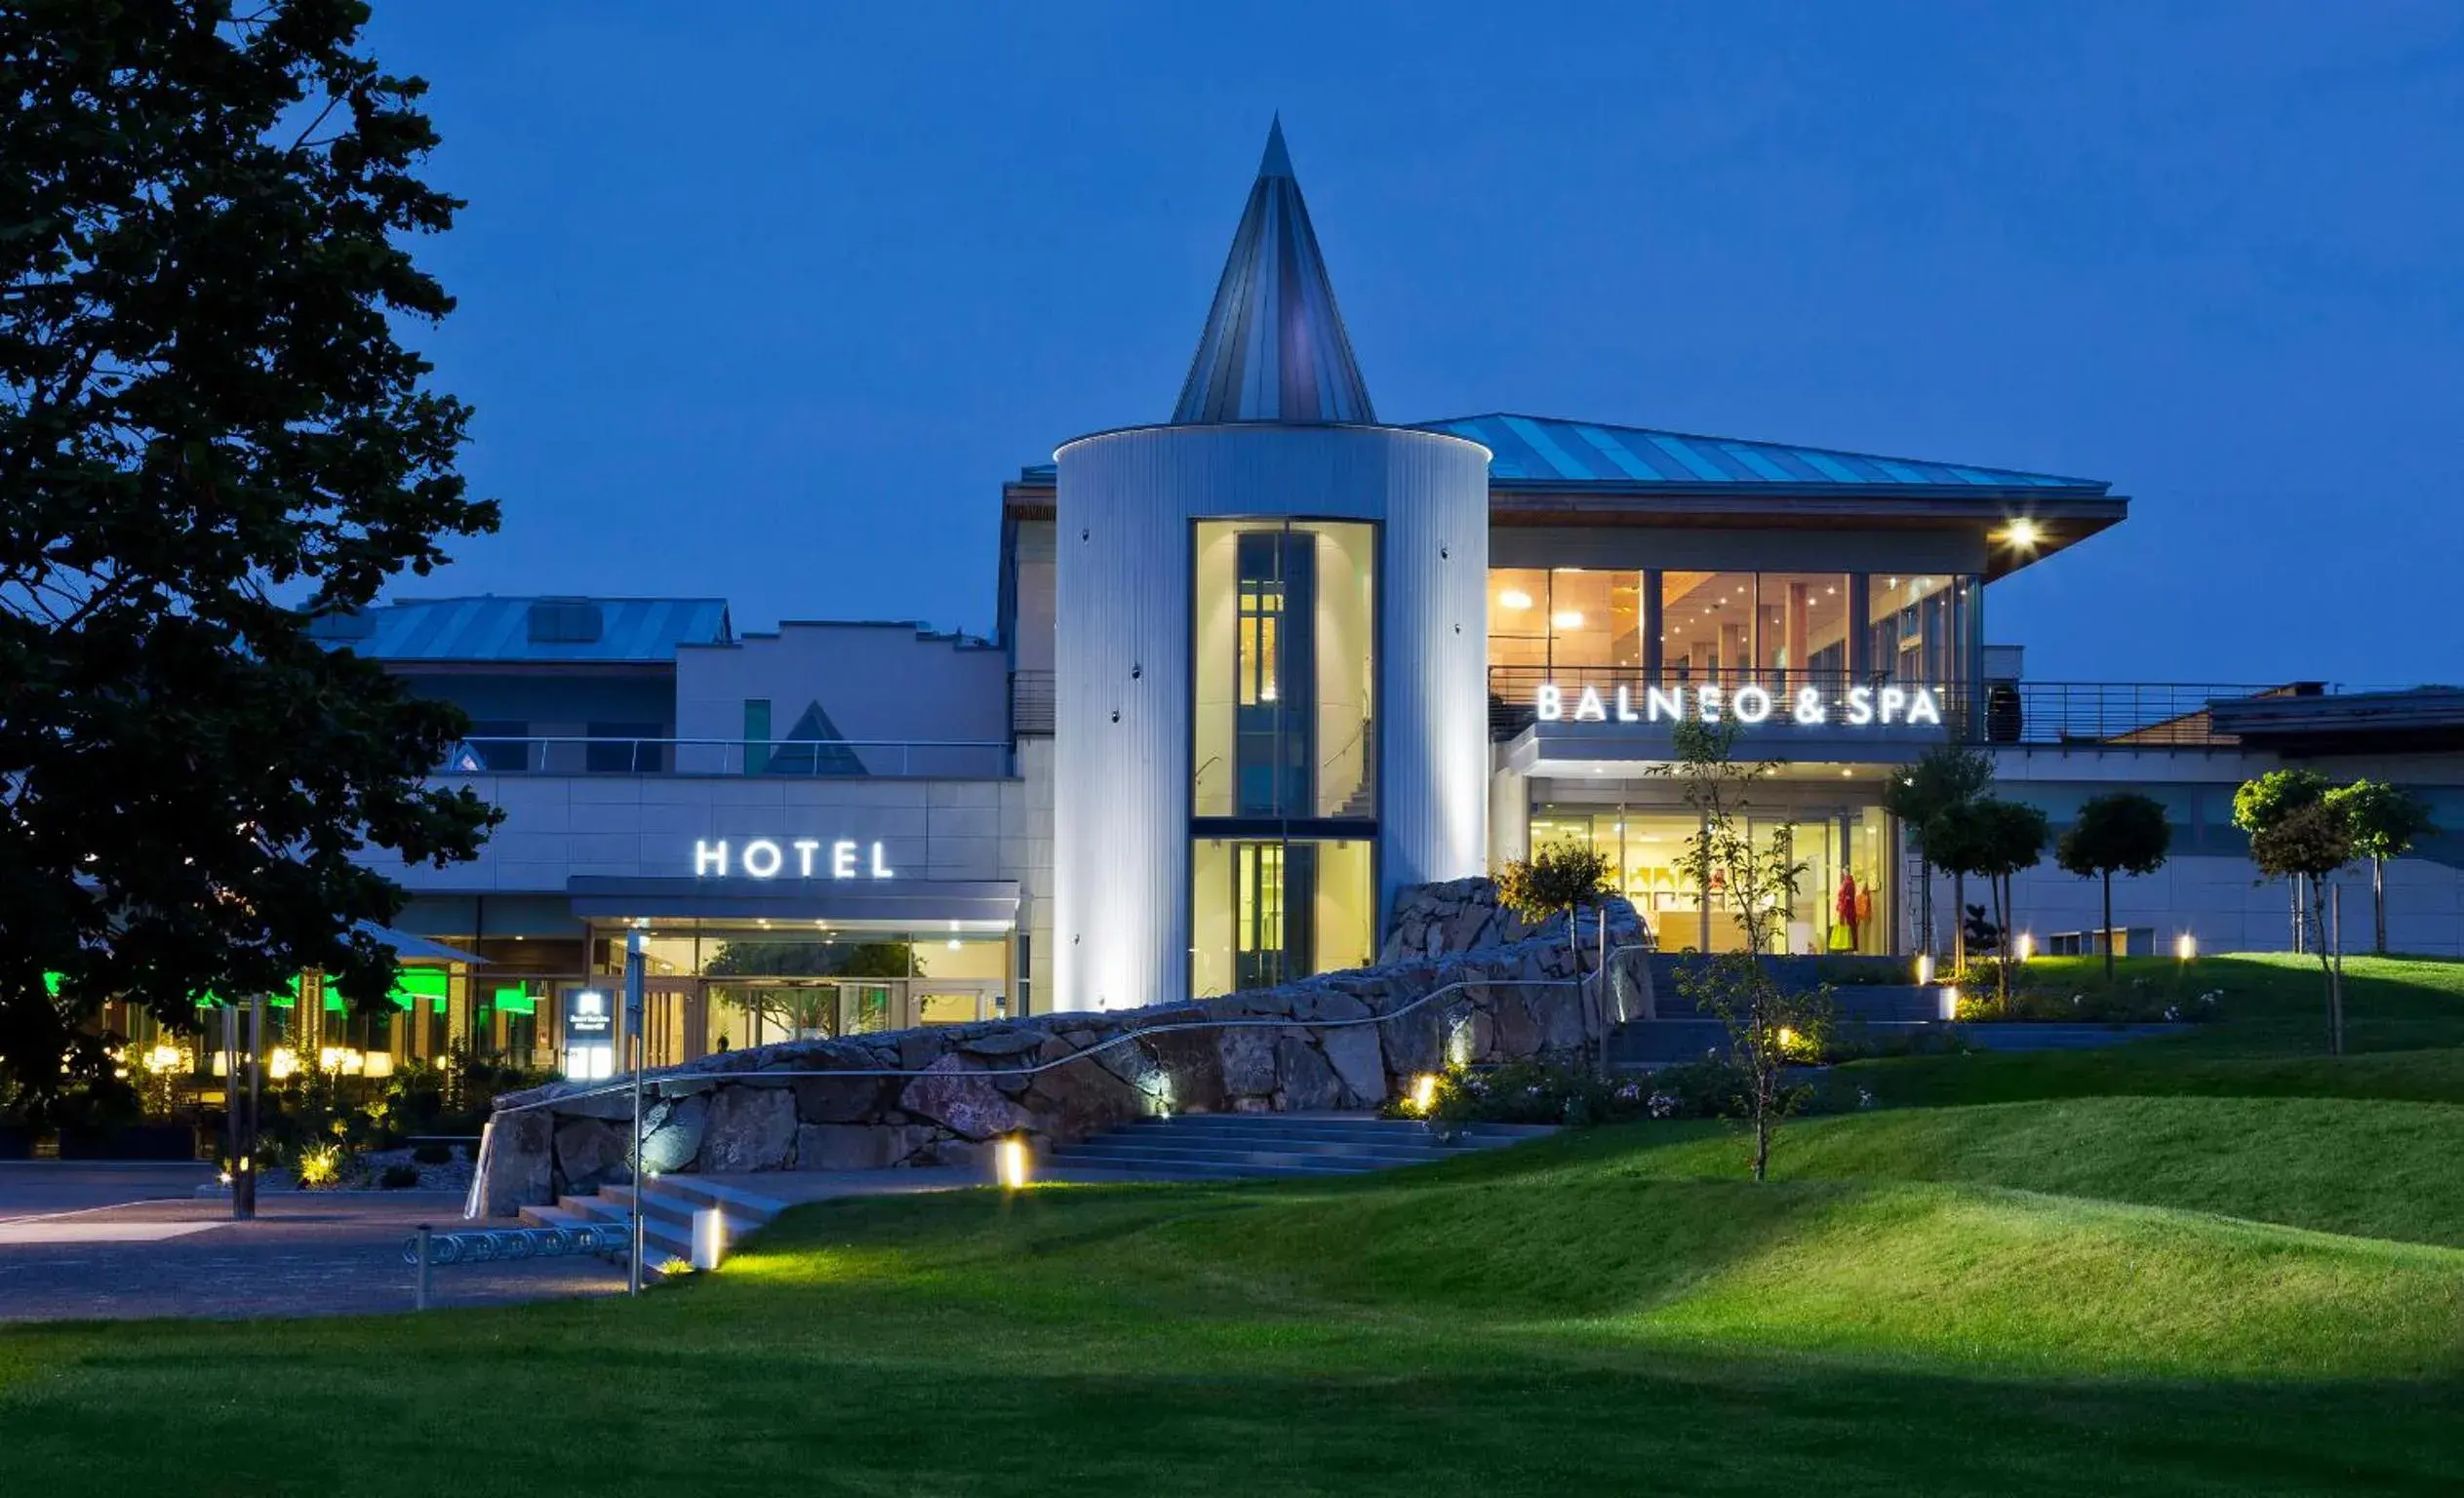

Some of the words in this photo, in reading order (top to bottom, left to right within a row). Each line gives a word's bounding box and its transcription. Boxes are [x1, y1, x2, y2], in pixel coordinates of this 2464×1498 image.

[1537, 686, 1770, 723] BALNEO
[1796, 688, 1825, 723] &
[1848, 688, 1940, 724] SPA
[695, 840, 894, 878] HOTEL
